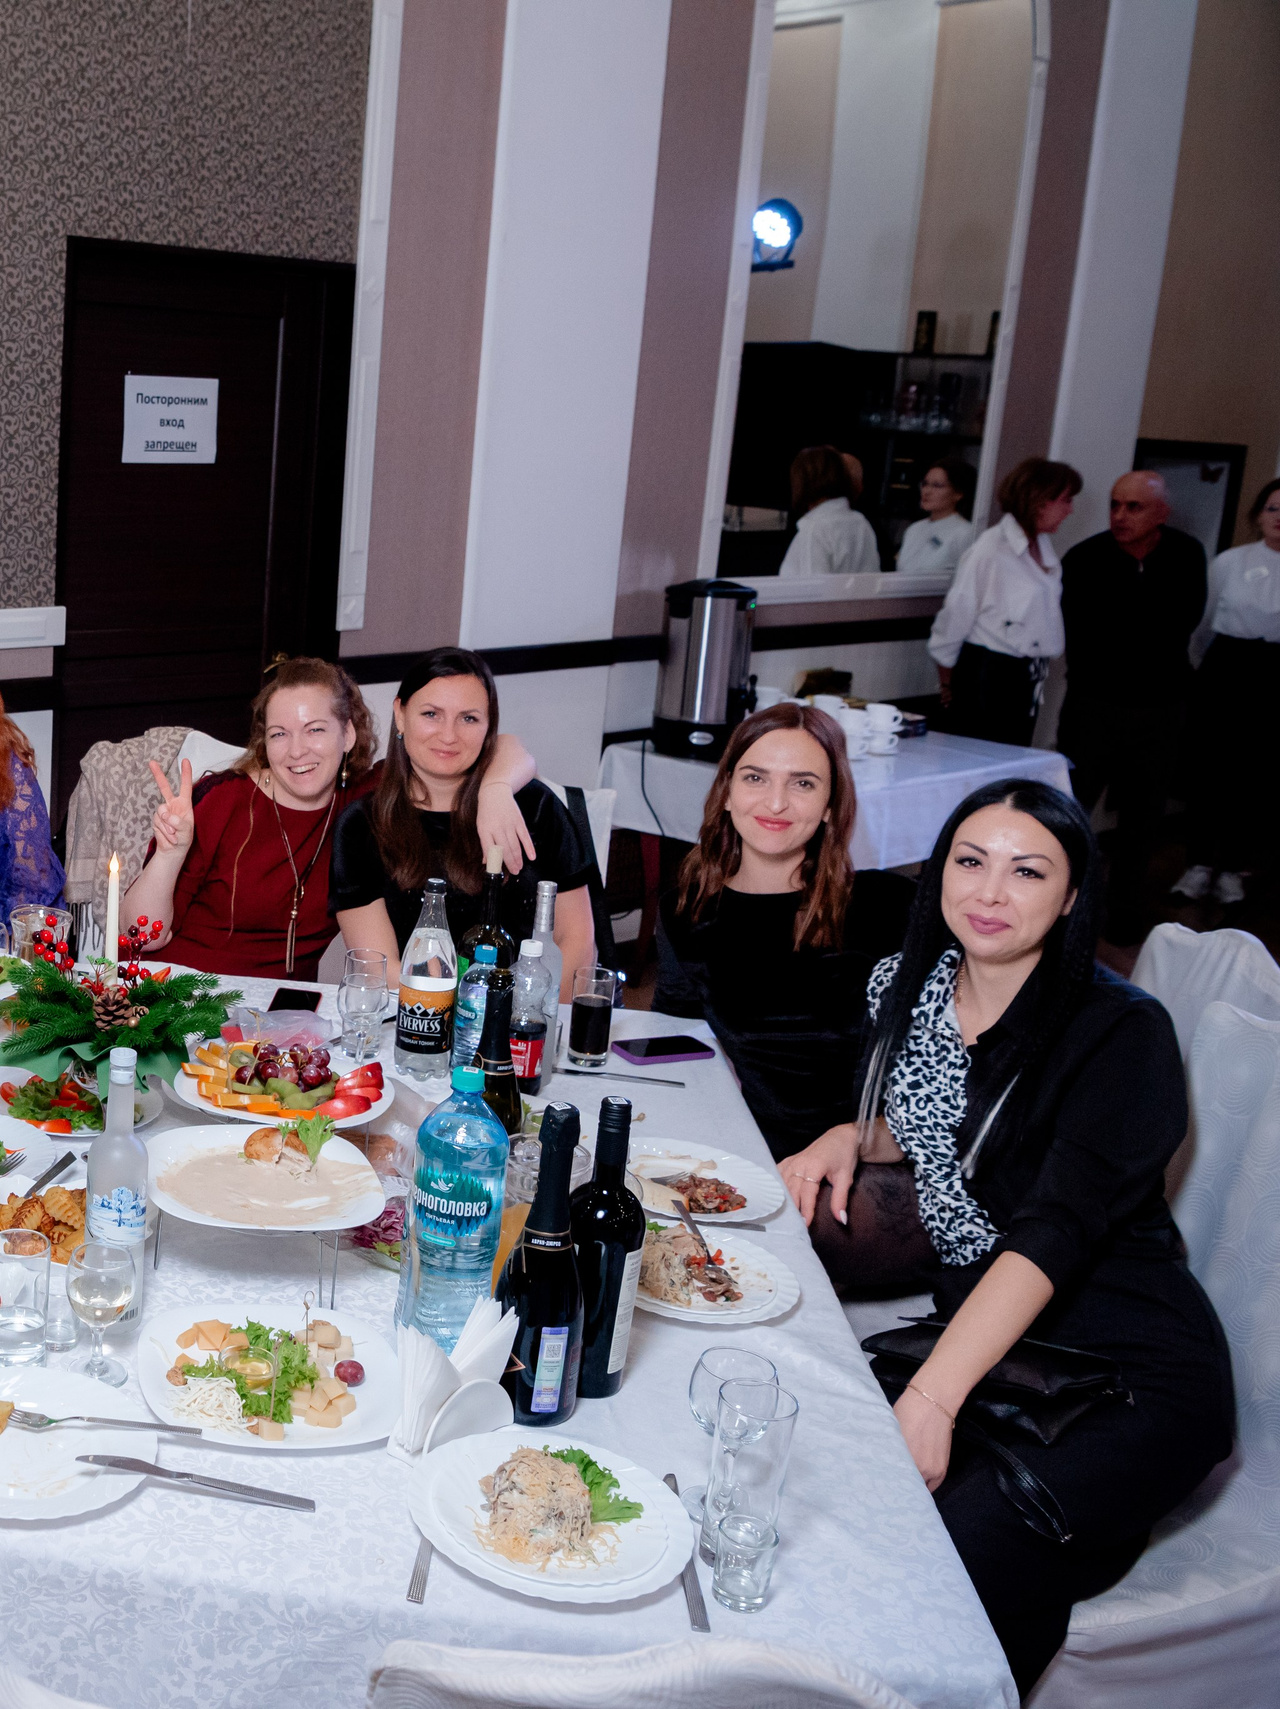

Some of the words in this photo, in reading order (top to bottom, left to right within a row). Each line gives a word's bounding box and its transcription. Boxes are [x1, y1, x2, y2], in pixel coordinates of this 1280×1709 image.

[136, 392, 208, 407] Посторонним
[160, 418, 185, 429] вход
[144, 440, 197, 453] запрещен
[399, 1012, 441, 1033] EVERVESS
